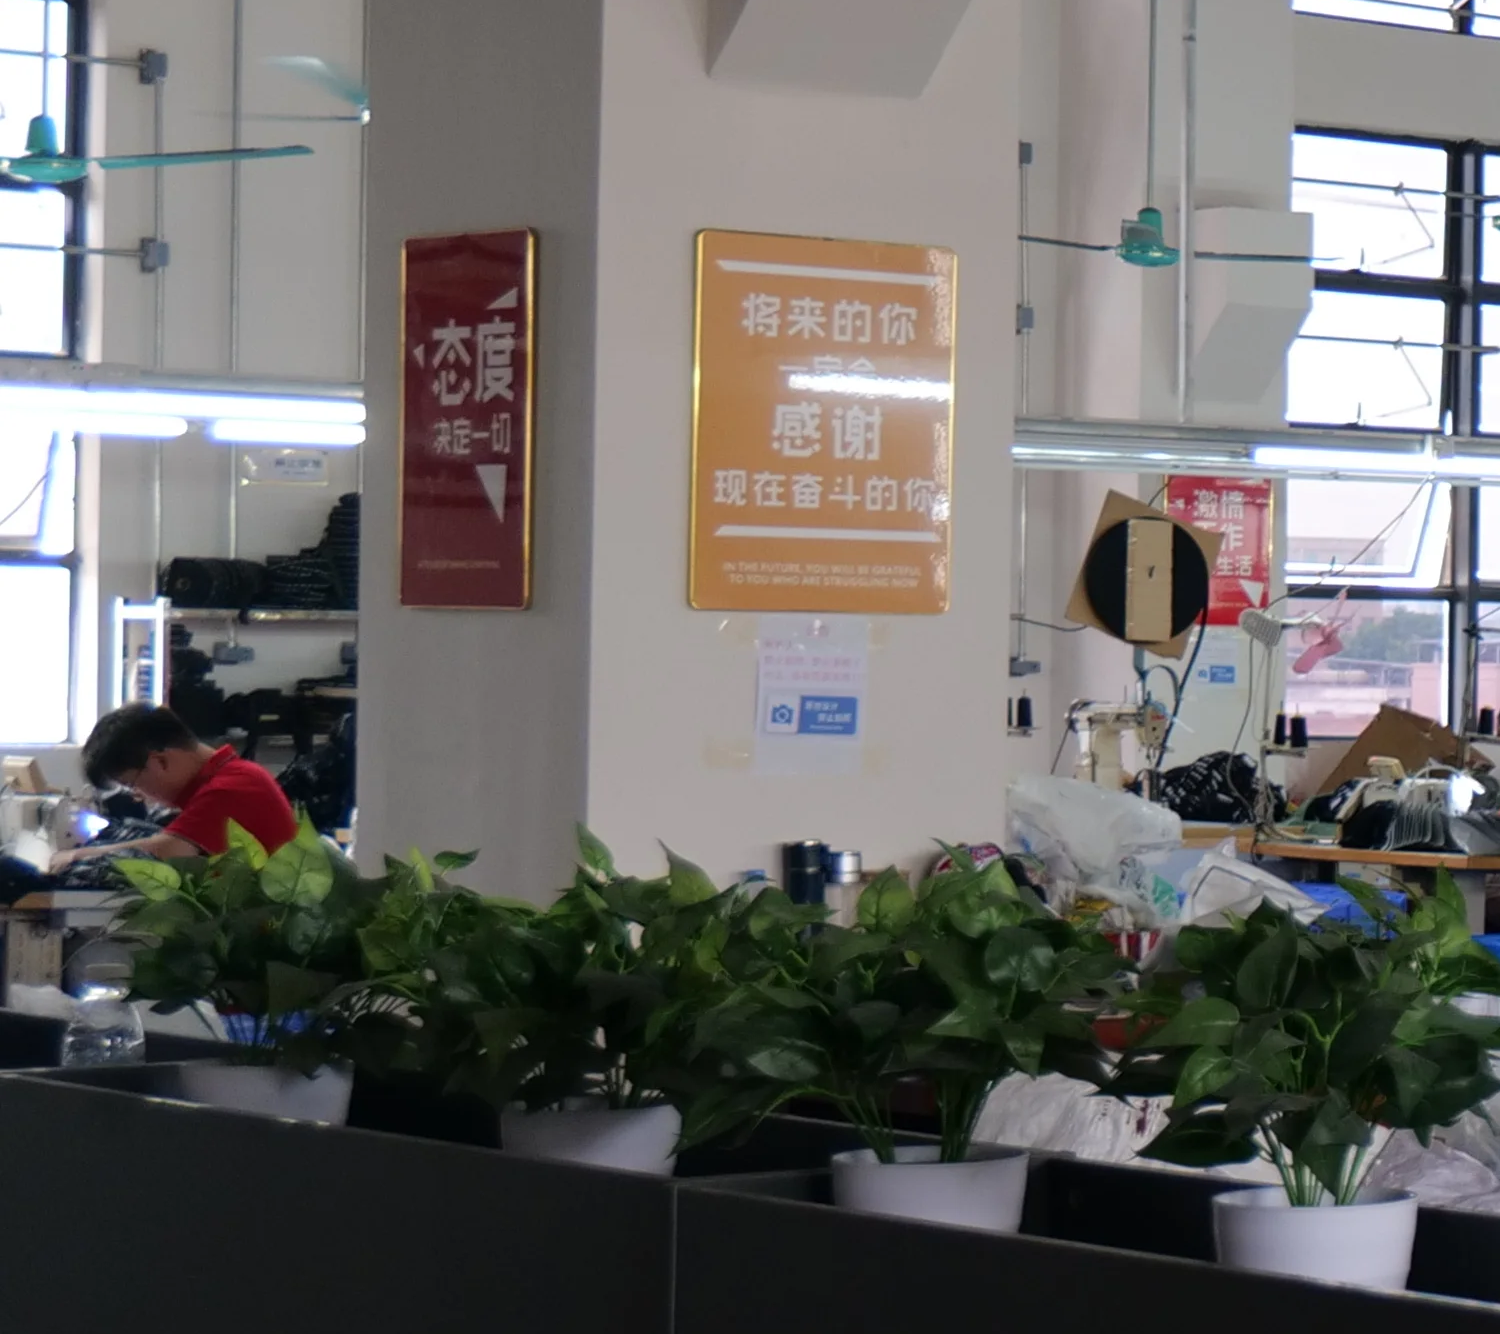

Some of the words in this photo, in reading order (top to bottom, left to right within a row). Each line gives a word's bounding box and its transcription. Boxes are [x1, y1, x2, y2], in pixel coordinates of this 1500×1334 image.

[742, 293, 918, 346] 将来的你
[432, 316, 516, 407] 态度
[433, 412, 511, 456] 决定一切
[772, 401, 884, 460] 感谢
[713, 469, 938, 512] 现在奋斗的你
[1193, 489, 1244, 519] 激情
